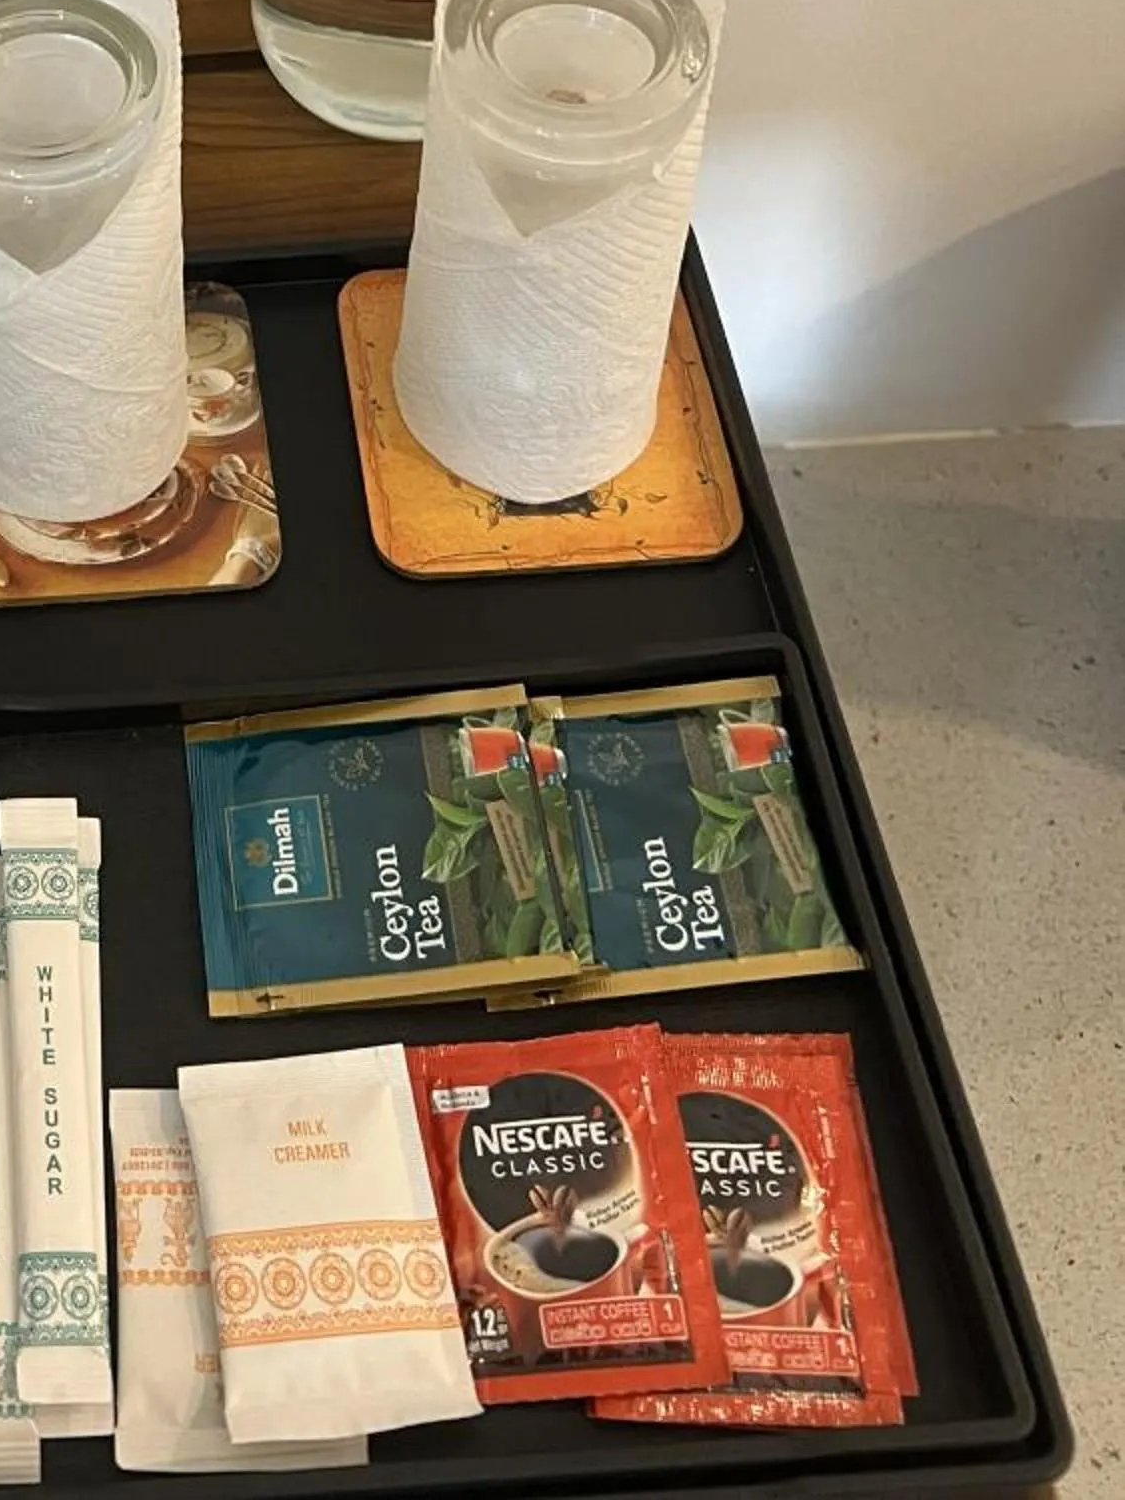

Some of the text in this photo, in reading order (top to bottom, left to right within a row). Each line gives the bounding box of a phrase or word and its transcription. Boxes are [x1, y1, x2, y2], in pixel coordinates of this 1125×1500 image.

[266, 807, 299, 895] Dilmah
[371, 843, 415, 962] Ceylon
[643, 835, 690, 952] Ceylon
[414, 895, 446, 959] Tea
[691, 885, 725, 950] Tea
[36, 965, 64, 1195] WHITE SUGAR
[288, 1118, 328, 1139] MILK
[274, 1141, 351, 1164] CREAMER
[491, 1152, 606, 1178] CLASSIC
[700, 1179, 783, 1197] ASSIC
[472, 1307, 497, 1337] 1.2
[599, 1301, 650, 1321] COFFEE
[662, 1301, 673, 1321] 1
